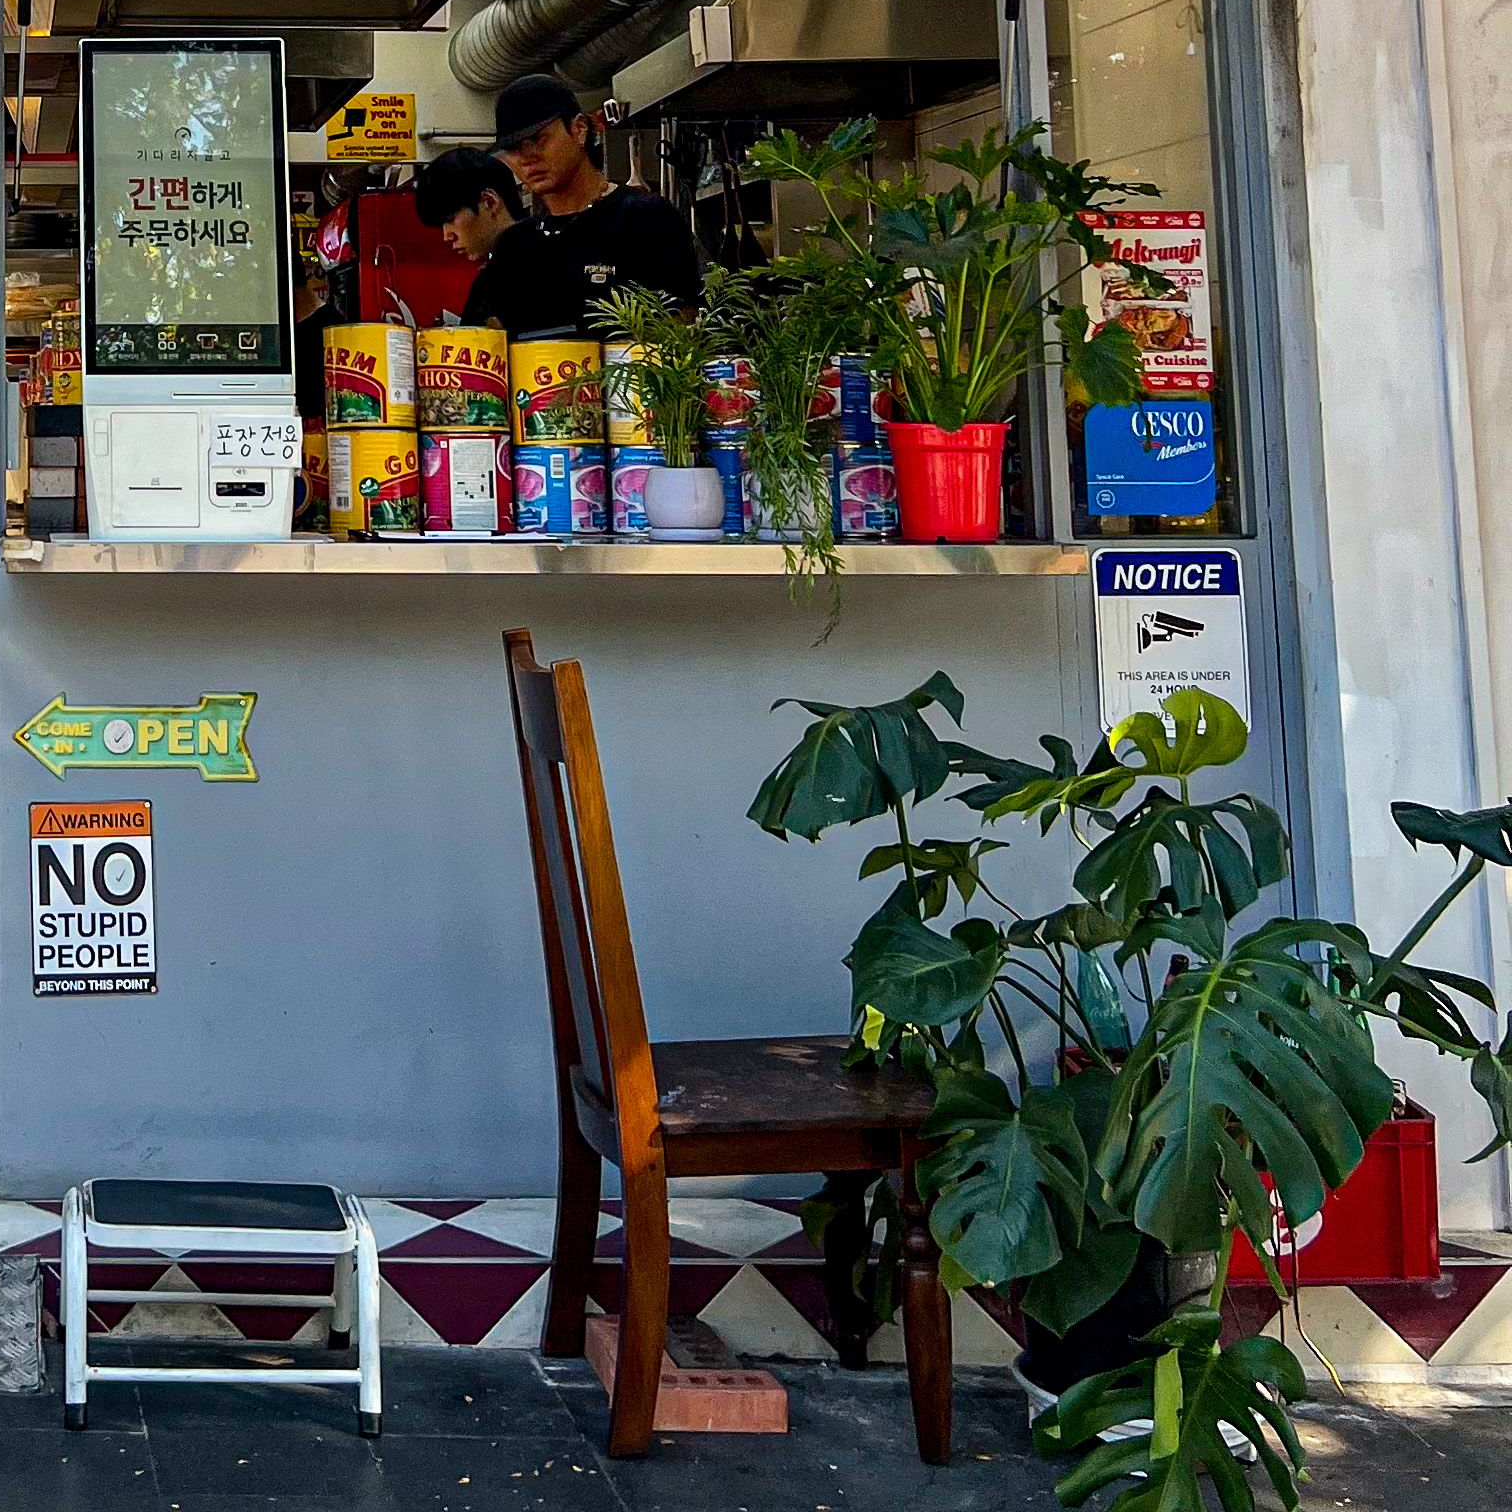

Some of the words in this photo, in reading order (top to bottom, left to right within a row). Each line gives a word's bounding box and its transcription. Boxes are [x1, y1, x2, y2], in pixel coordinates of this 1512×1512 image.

[371, 96, 405, 107] Smile
[370, 108, 407, 121] you're
[380, 120, 397, 129] on
[128, 176, 243, 212] 간편하게
[118, 218, 254, 248] 주문하세요
[441, 344, 507, 378] FARM
[1154, 355, 1208, 366] Cuisine
[417, 370, 462, 388] CHOS
[1131, 411, 1204, 437] CESCO
[216, 424, 257, 457] 포장
[261, 425, 298, 459] 전용
[1156, 439, 1207, 461] Members
[384, 450, 417, 476] GO
[1114, 563, 1222, 591] NOTICE
[1117, 671, 1143, 681] THIS
[1144, 670, 1174, 681] AREA
[1177, 670, 1189, 680] IS
[1190, 670, 1231, 681] UNDER
[1150, 685, 1164, 694] 24
[37, 722, 93, 737] COME
[54, 739, 74, 754] IN
[62, 813, 145, 829] WARNING
[37, 842, 147, 906] NO
[39, 912, 148, 938] STUPID
[39, 943, 150, 969] PEOPLE
[39, 980, 86, 993] BEYOND
[88, 980, 114, 991] THIS
[116, 979, 150, 990] POINT
